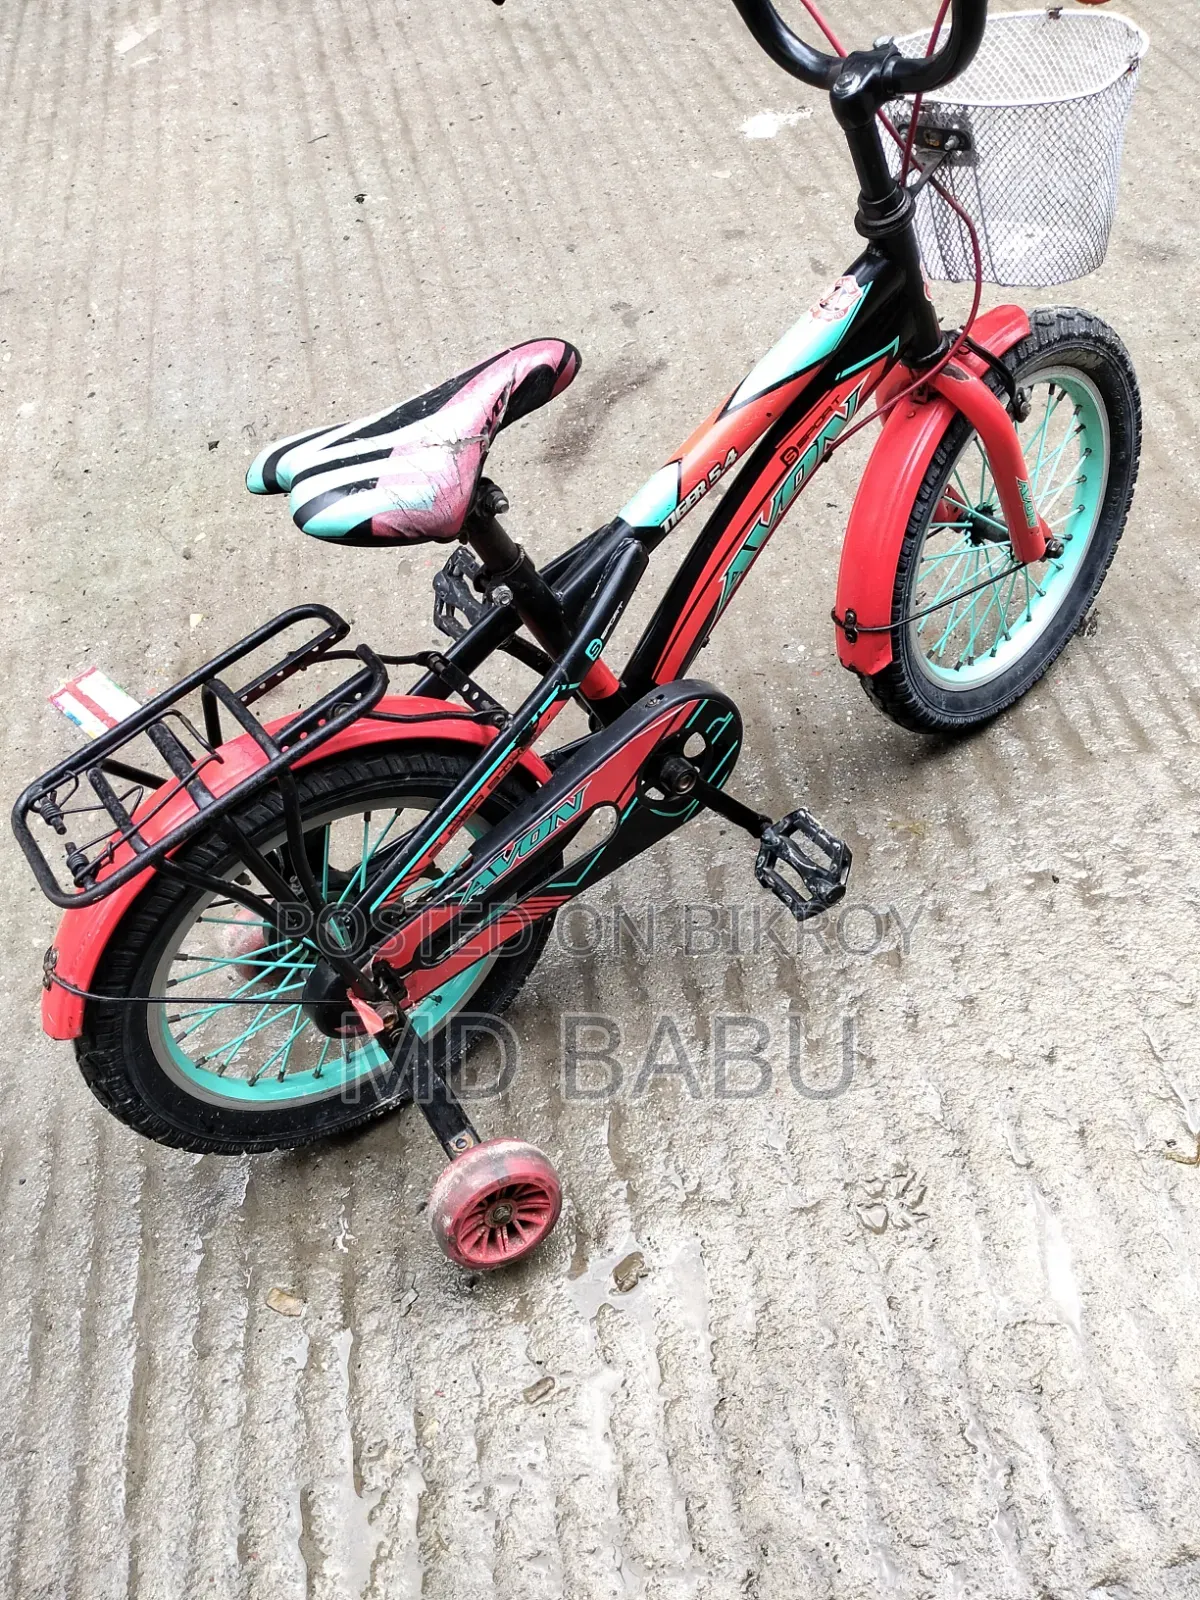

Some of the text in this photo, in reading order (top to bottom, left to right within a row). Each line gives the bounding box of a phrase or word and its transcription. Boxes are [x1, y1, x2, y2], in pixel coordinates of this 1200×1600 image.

[796, 394, 840, 449] SPORT
[660, 447, 738, 533] TIGER 5.4
[716, 372, 870, 614] AVON
[1016, 477, 1039, 528] AVON
[458, 782, 590, 905] AVON
